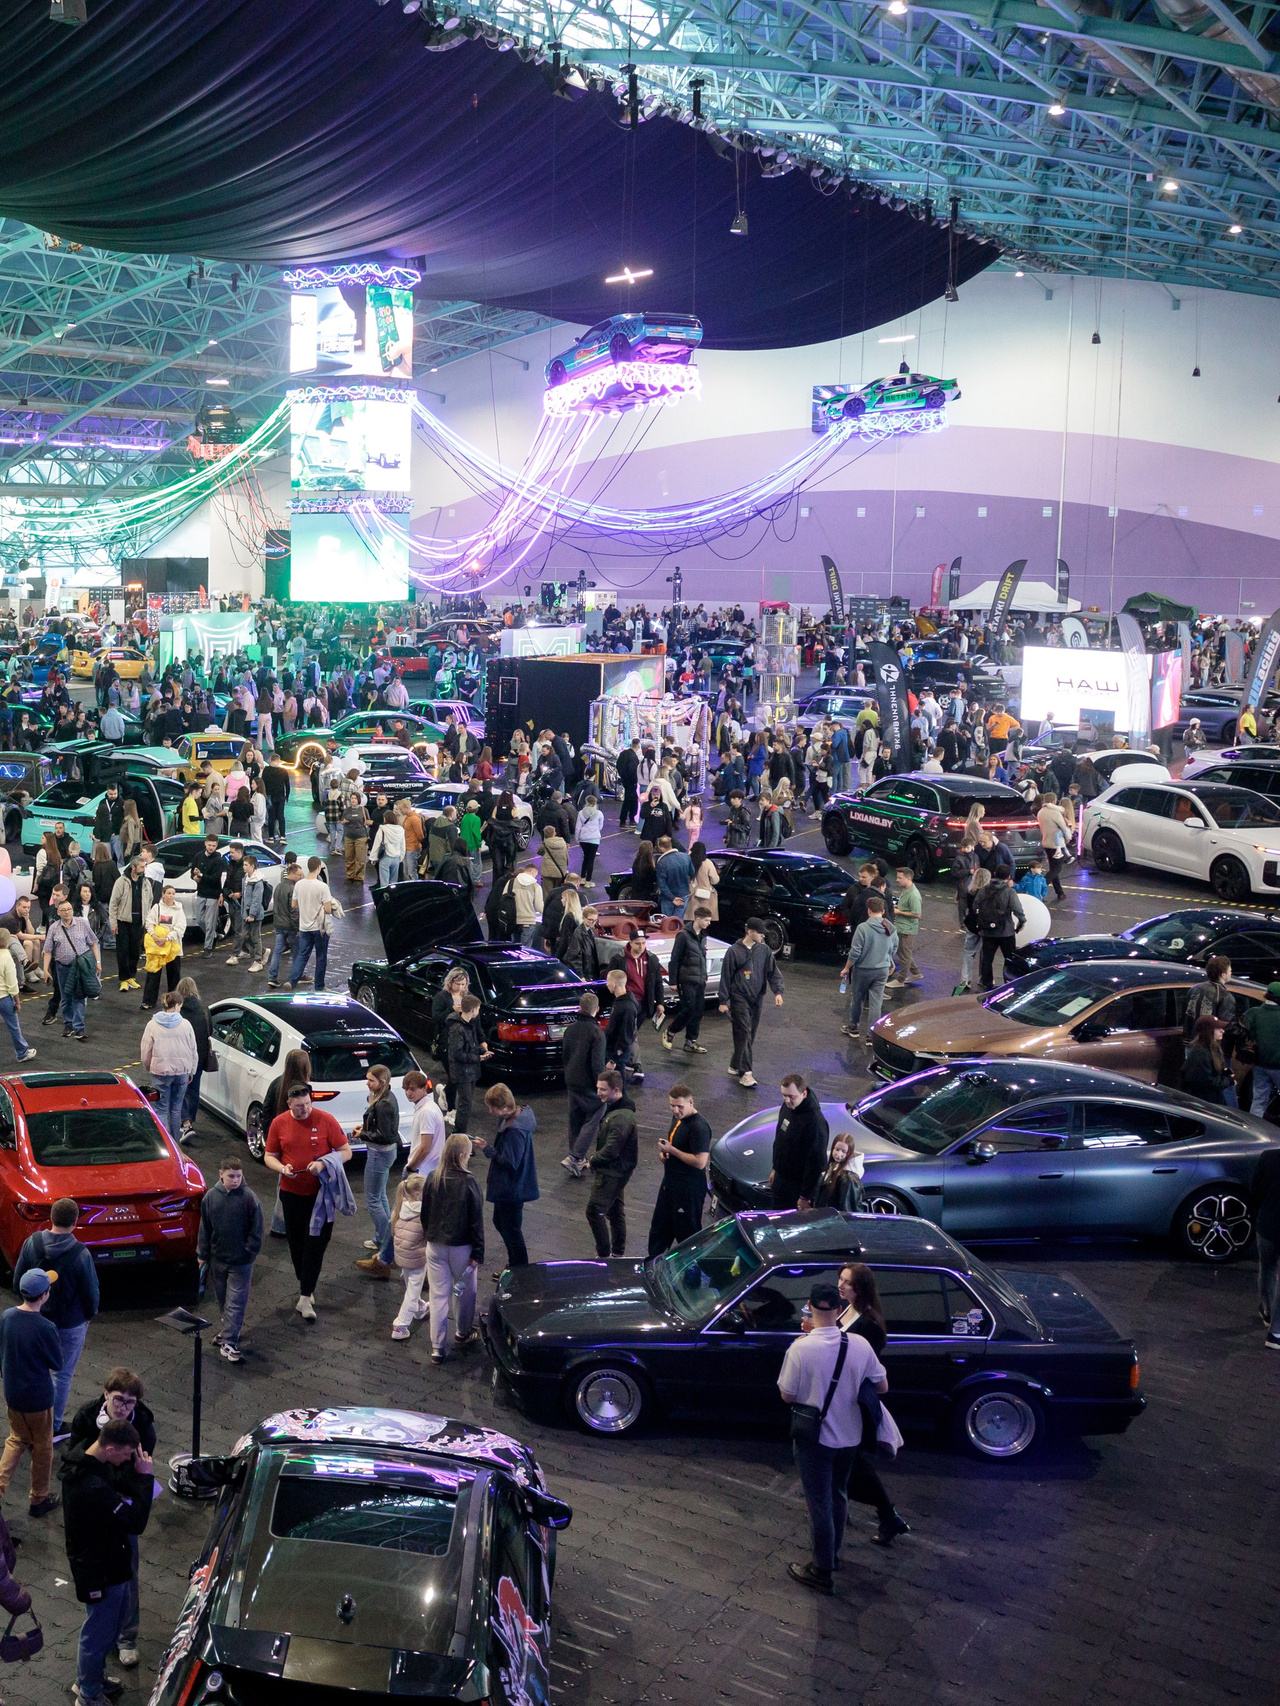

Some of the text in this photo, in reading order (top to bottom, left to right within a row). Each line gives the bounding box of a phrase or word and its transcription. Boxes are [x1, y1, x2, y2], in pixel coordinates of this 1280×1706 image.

[885, 391, 916, 401] BETERA
[990, 572, 1015, 632] STAYKI DRIFT
[849, 810, 894, 829] LIXIANG.BY
